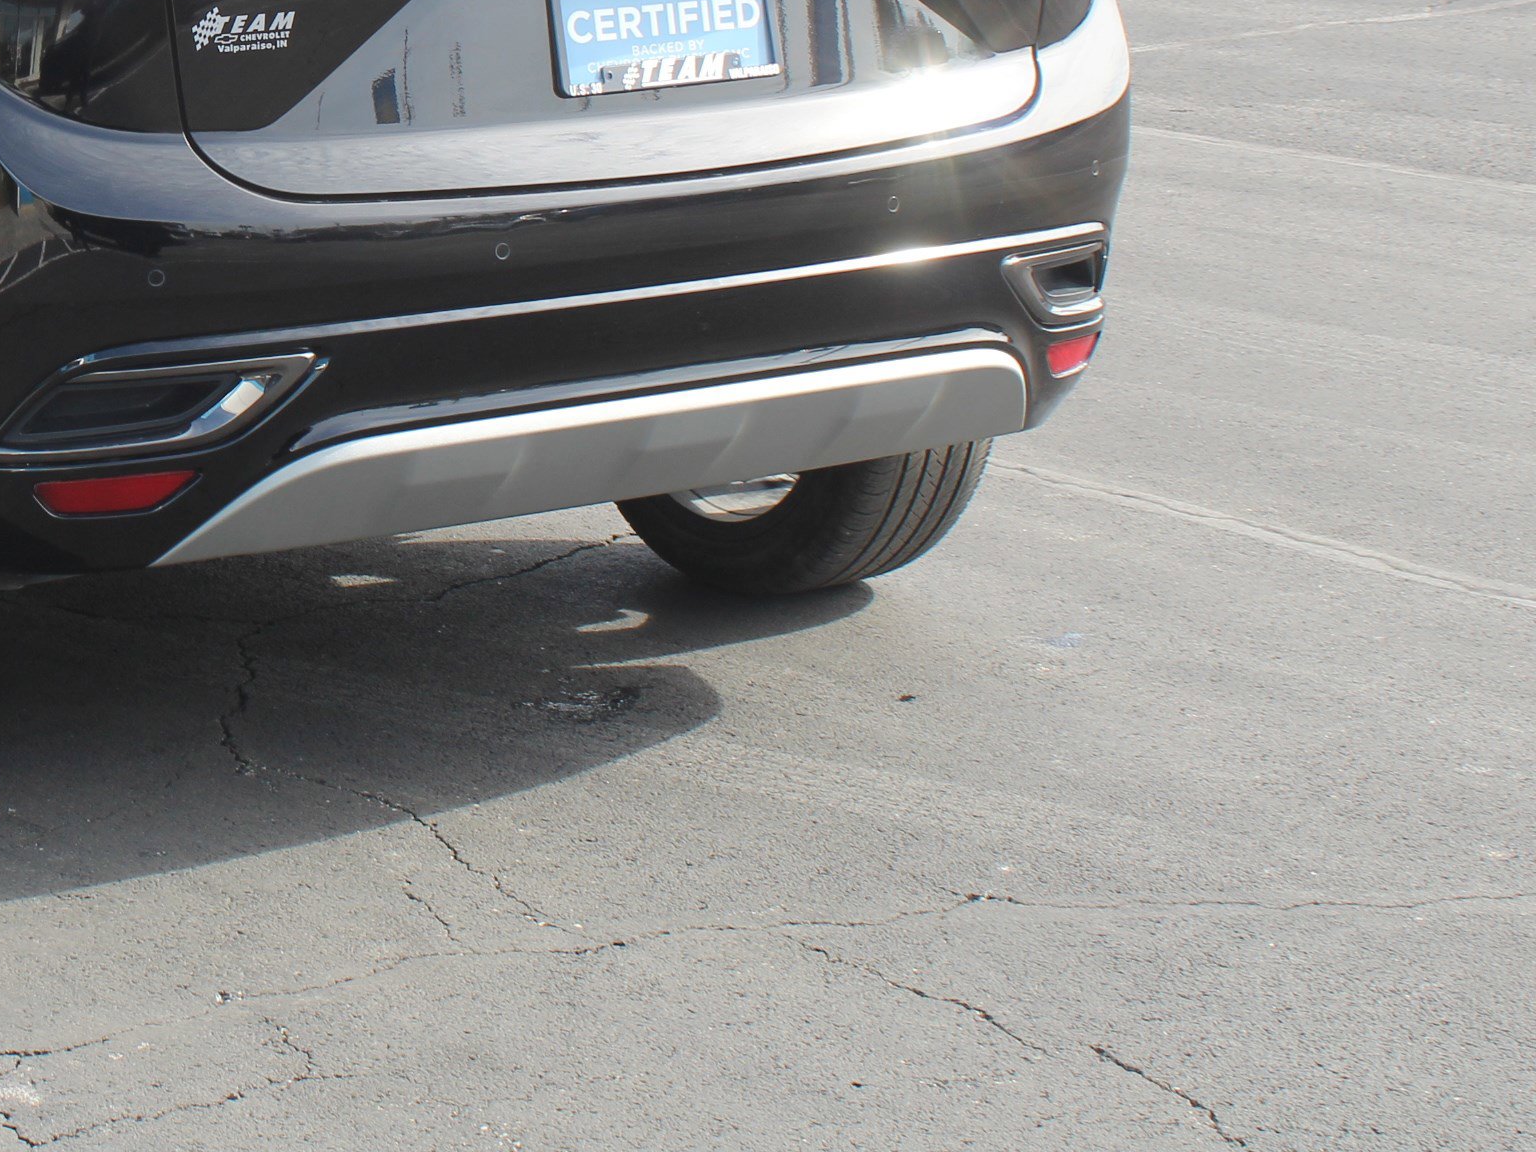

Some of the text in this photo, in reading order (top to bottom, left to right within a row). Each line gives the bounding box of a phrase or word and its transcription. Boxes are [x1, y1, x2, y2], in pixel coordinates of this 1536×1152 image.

[211, 11, 295, 34] TEAM
[240, 31, 290, 42] CHEVROLET
[218, 40, 288, 54] Valparaiso, IN
[631, 39, 705, 56] BACKED BY
[641, 52, 726, 87] TEAM
